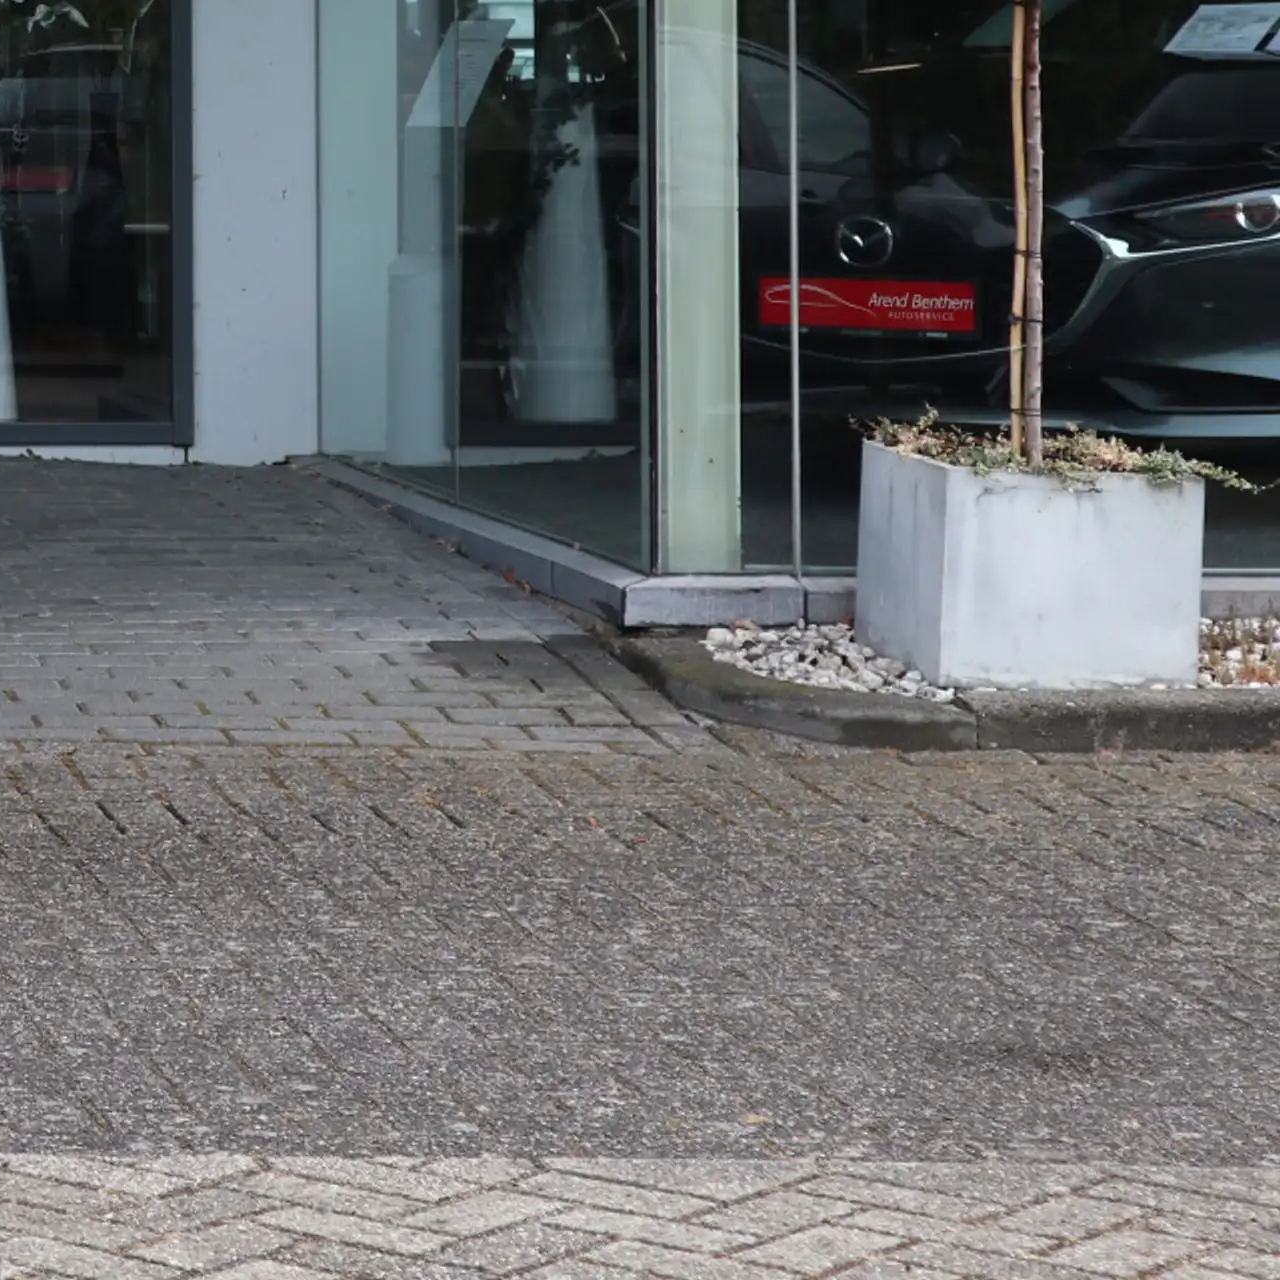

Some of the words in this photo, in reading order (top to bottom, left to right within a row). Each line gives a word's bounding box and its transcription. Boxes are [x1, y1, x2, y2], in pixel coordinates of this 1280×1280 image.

[868, 292, 908, 308] Arend
[911, 294, 974, 311] Benthem
[888, 311, 955, 322] AUTOSERVICE
